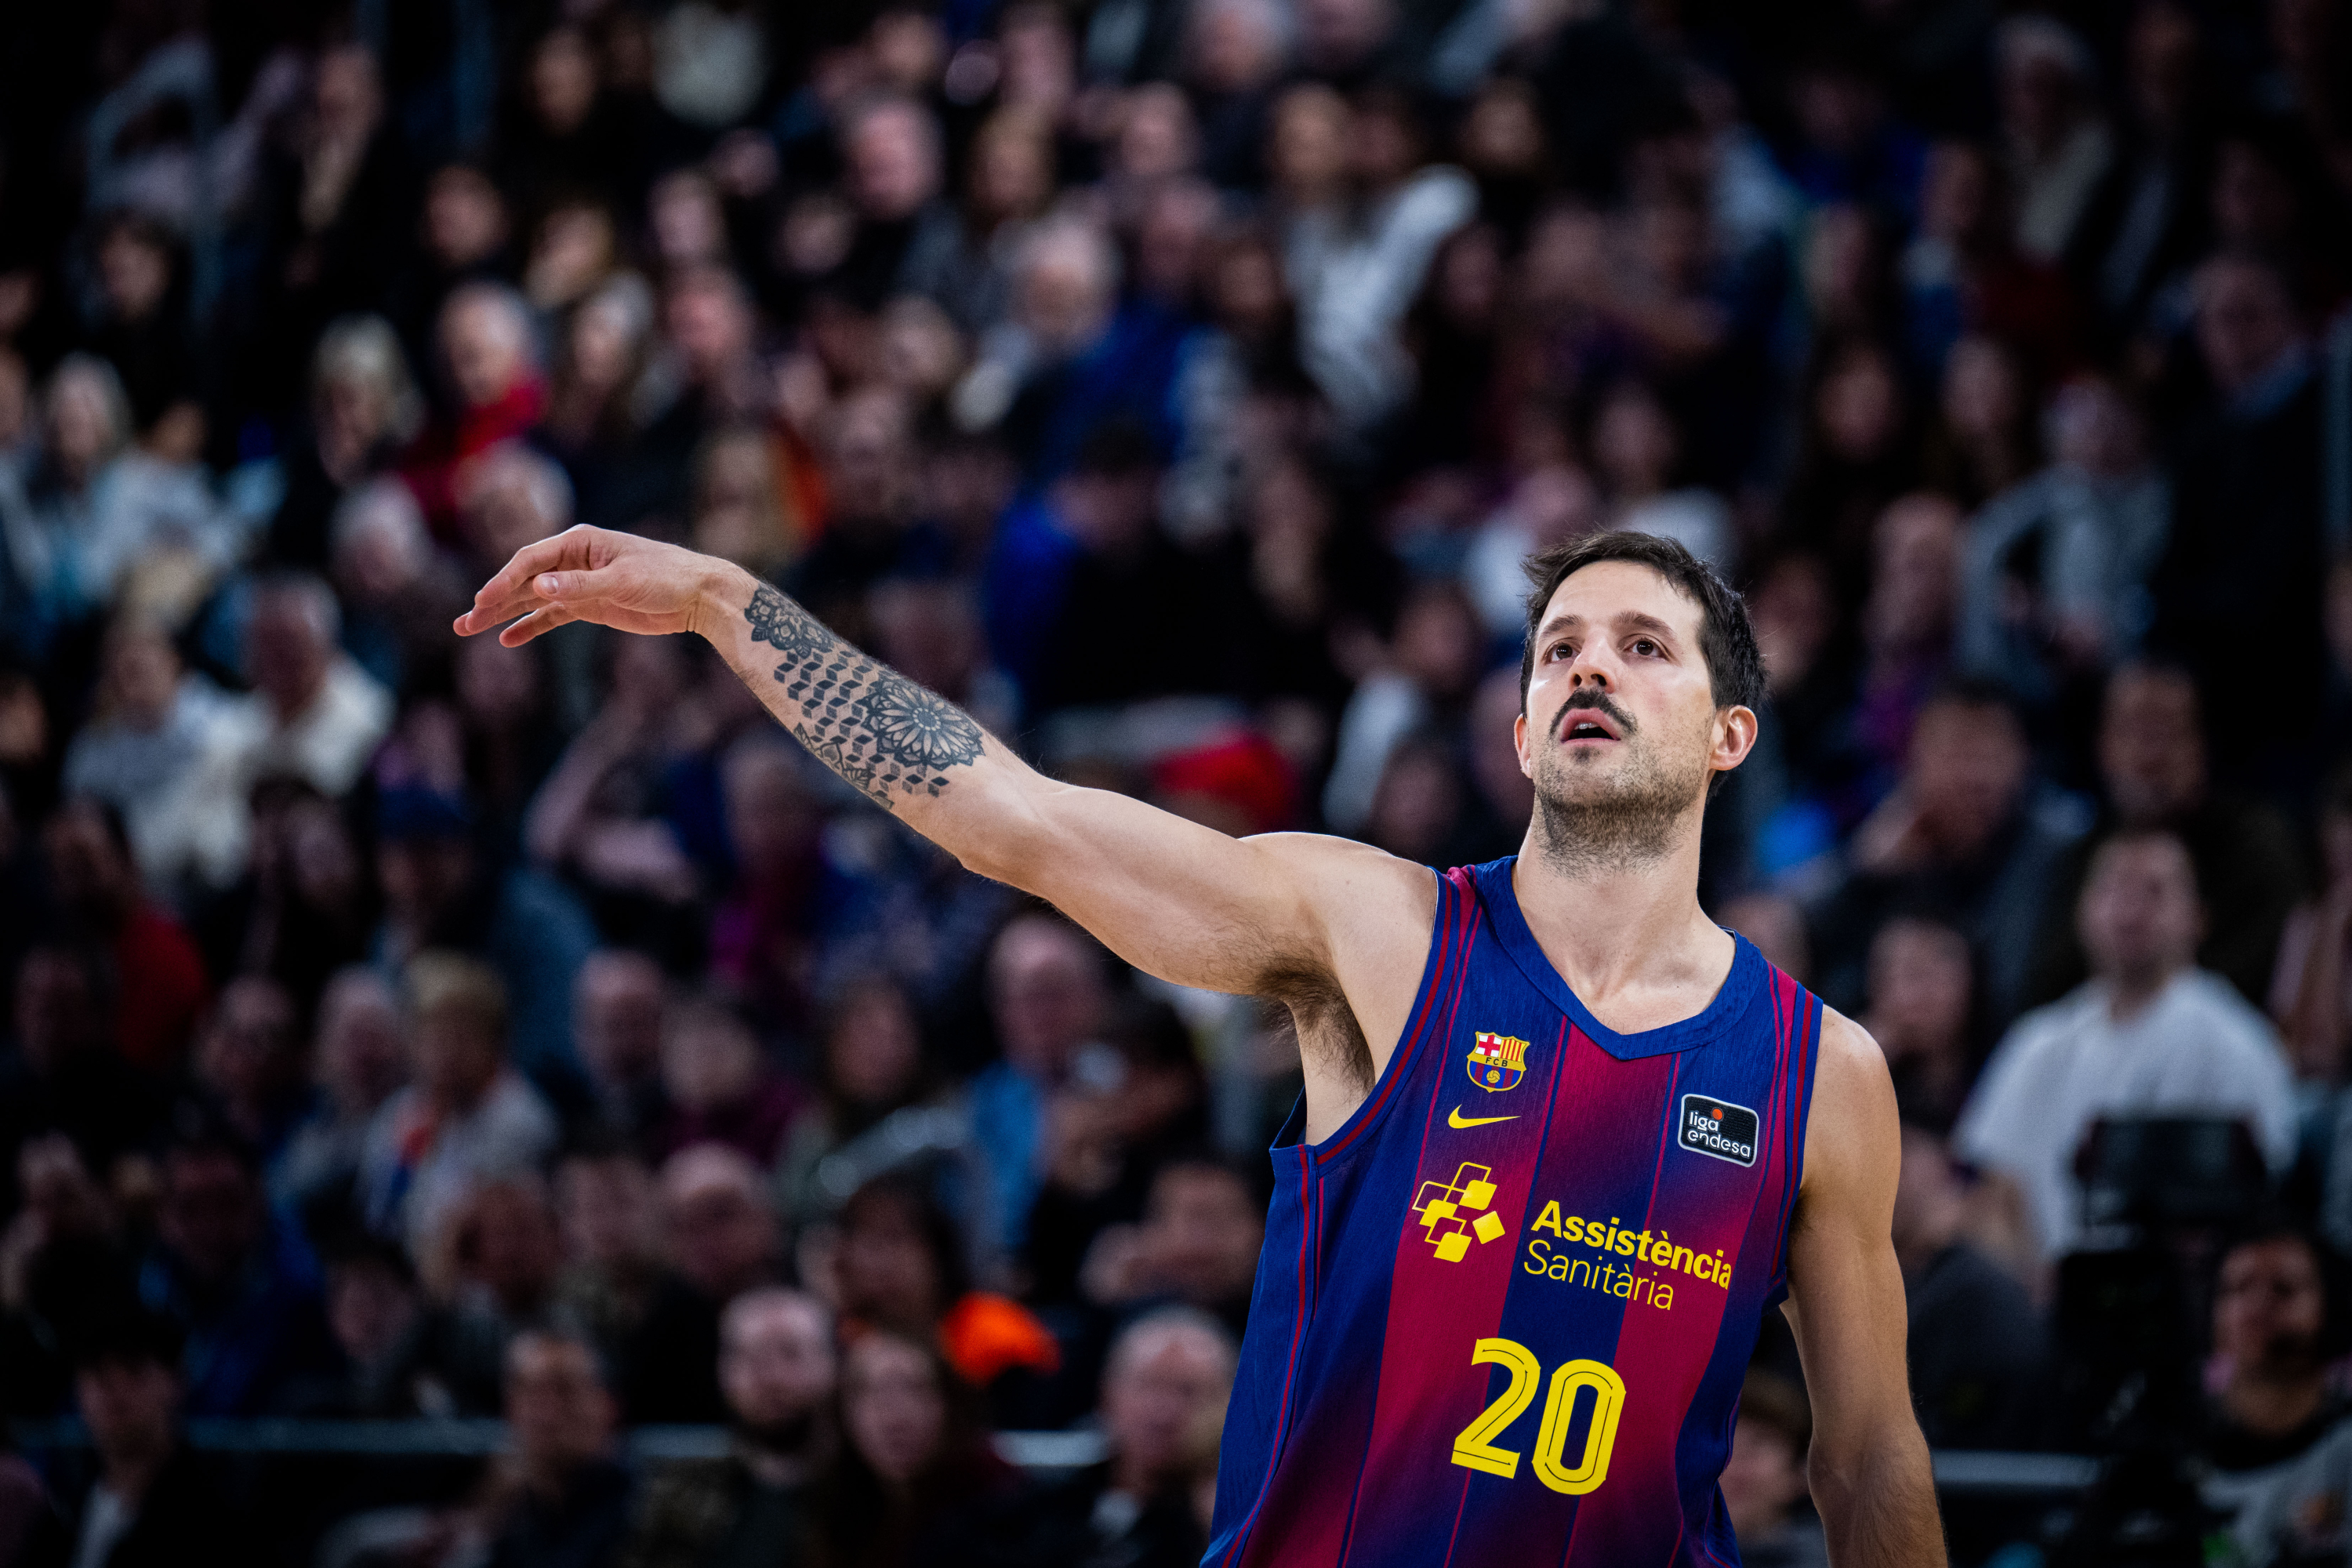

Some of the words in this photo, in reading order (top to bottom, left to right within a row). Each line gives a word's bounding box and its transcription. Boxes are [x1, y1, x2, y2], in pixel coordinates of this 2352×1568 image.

[1687, 1130, 1751, 1158] endesa
[1689, 1112, 1719, 1131] liga
[1524, 1239, 1674, 1310] Sanitària
[1530, 1200, 1732, 1290] Assistència
[1451, 1338, 1626, 1495] 20
